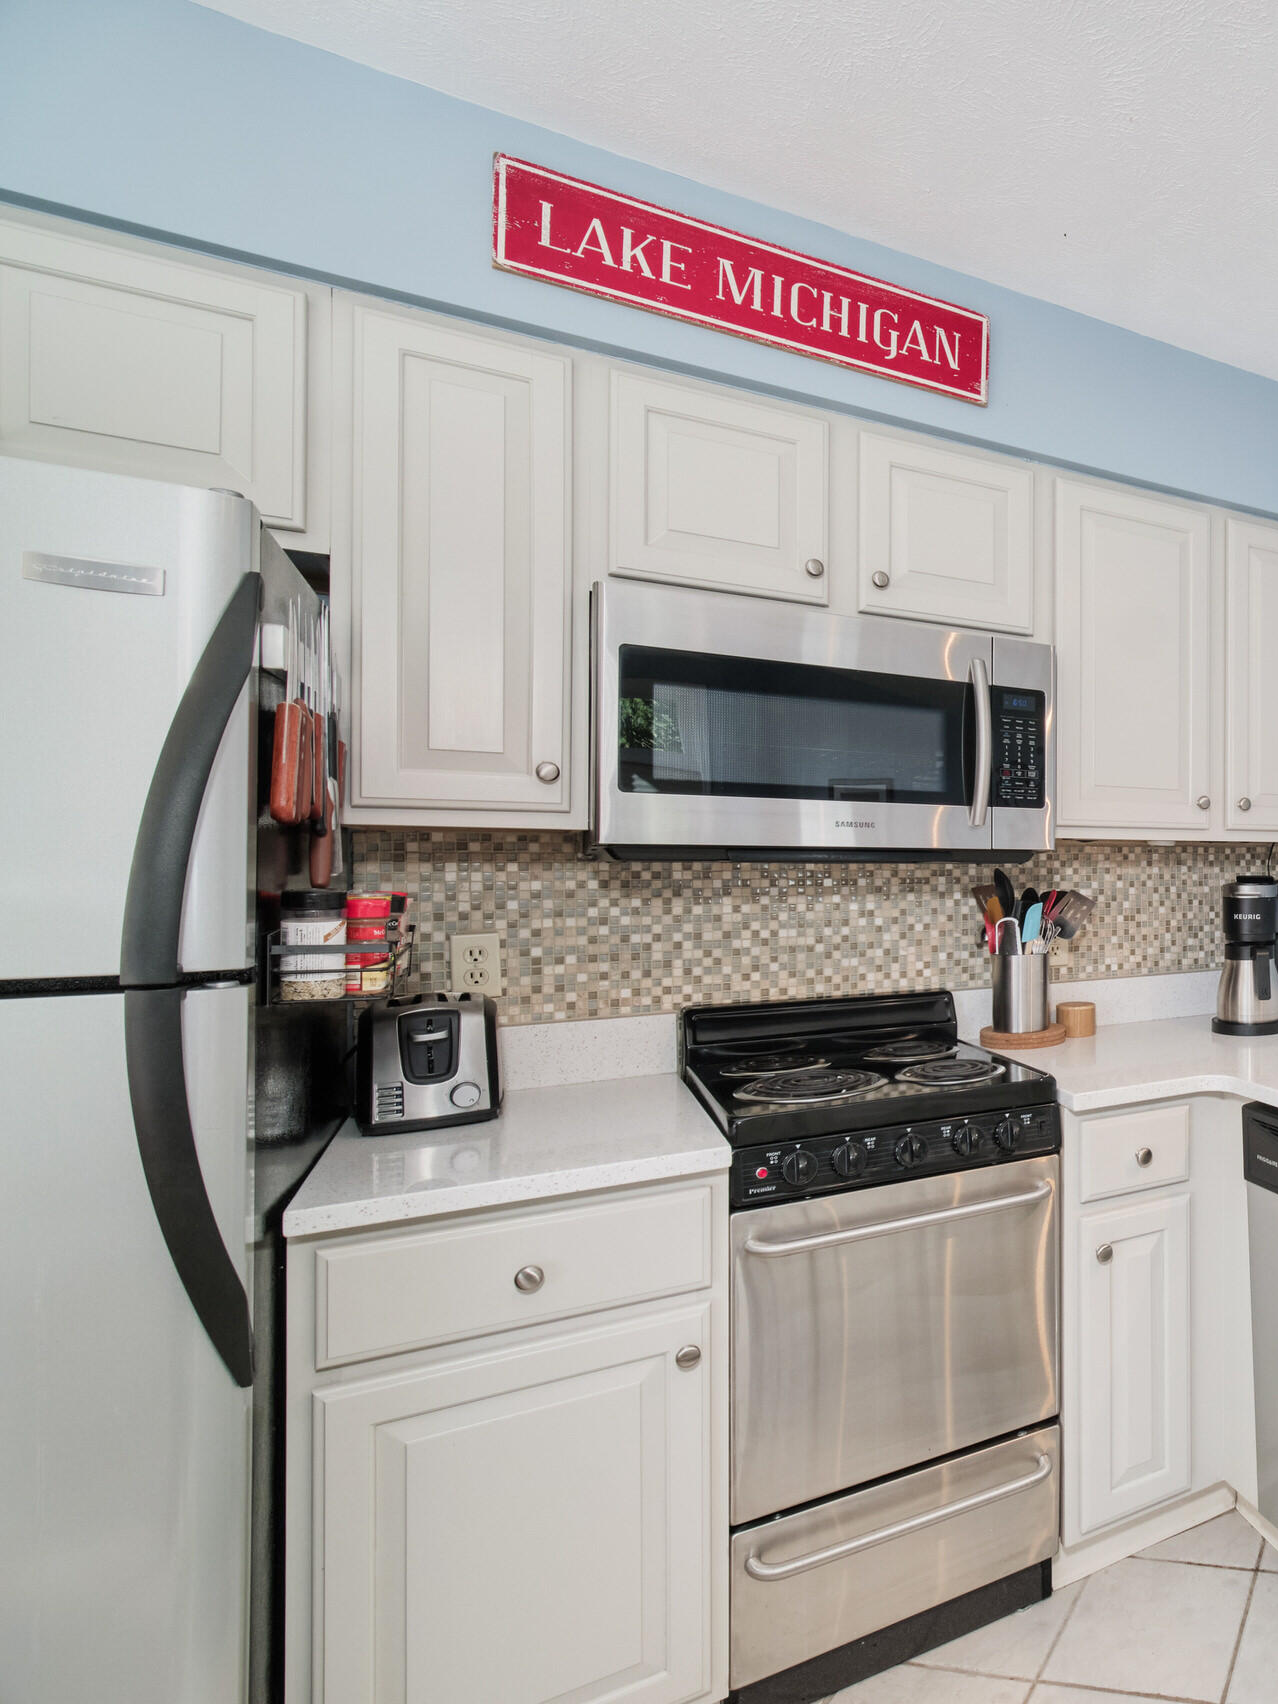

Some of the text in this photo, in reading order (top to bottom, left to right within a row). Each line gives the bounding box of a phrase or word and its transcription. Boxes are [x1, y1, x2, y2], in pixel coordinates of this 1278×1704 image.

[538, 200, 962, 371] LAKE MICHIGAN
[834, 820, 876, 829] SAMSUNG
[766, 1150, 782, 1158] FRONT
[748, 1184, 777, 1195] Premier
